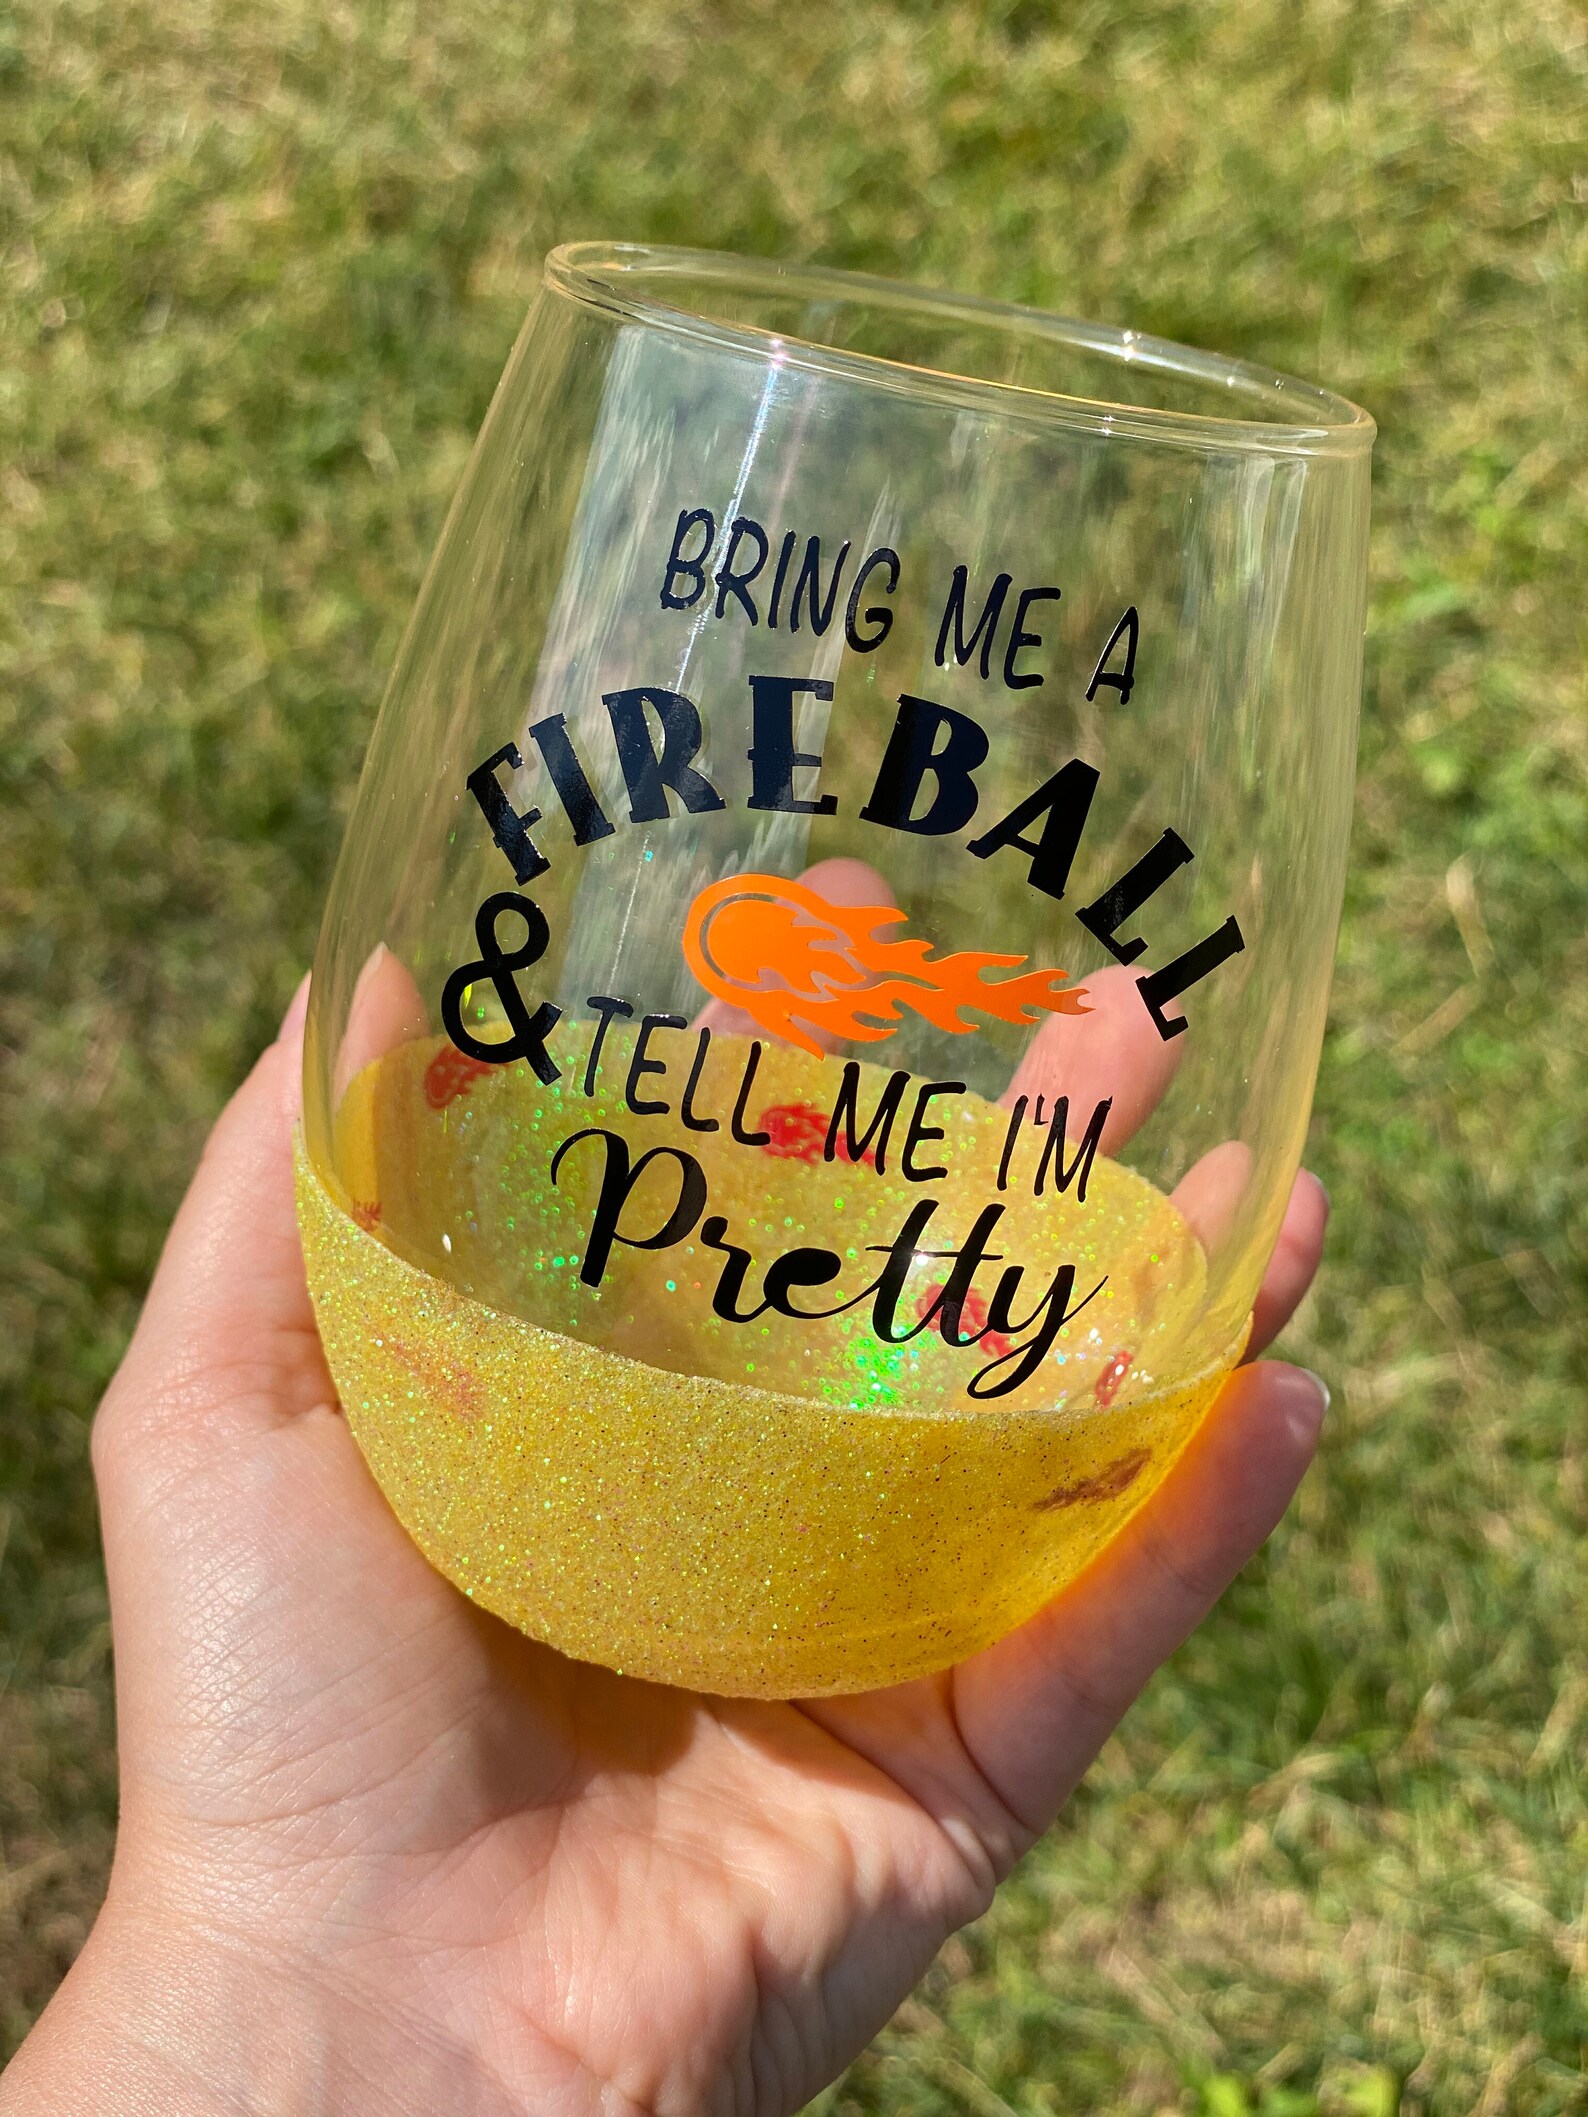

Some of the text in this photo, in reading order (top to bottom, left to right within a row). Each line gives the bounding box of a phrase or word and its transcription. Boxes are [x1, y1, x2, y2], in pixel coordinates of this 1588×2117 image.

[659, 508, 1140, 706] BRING ME A
[465, 674, 1246, 1042] FIREBALL
[440, 891, 1114, 1203] & TELL ME I'M
[550, 1128, 1109, 1400] Pretty
